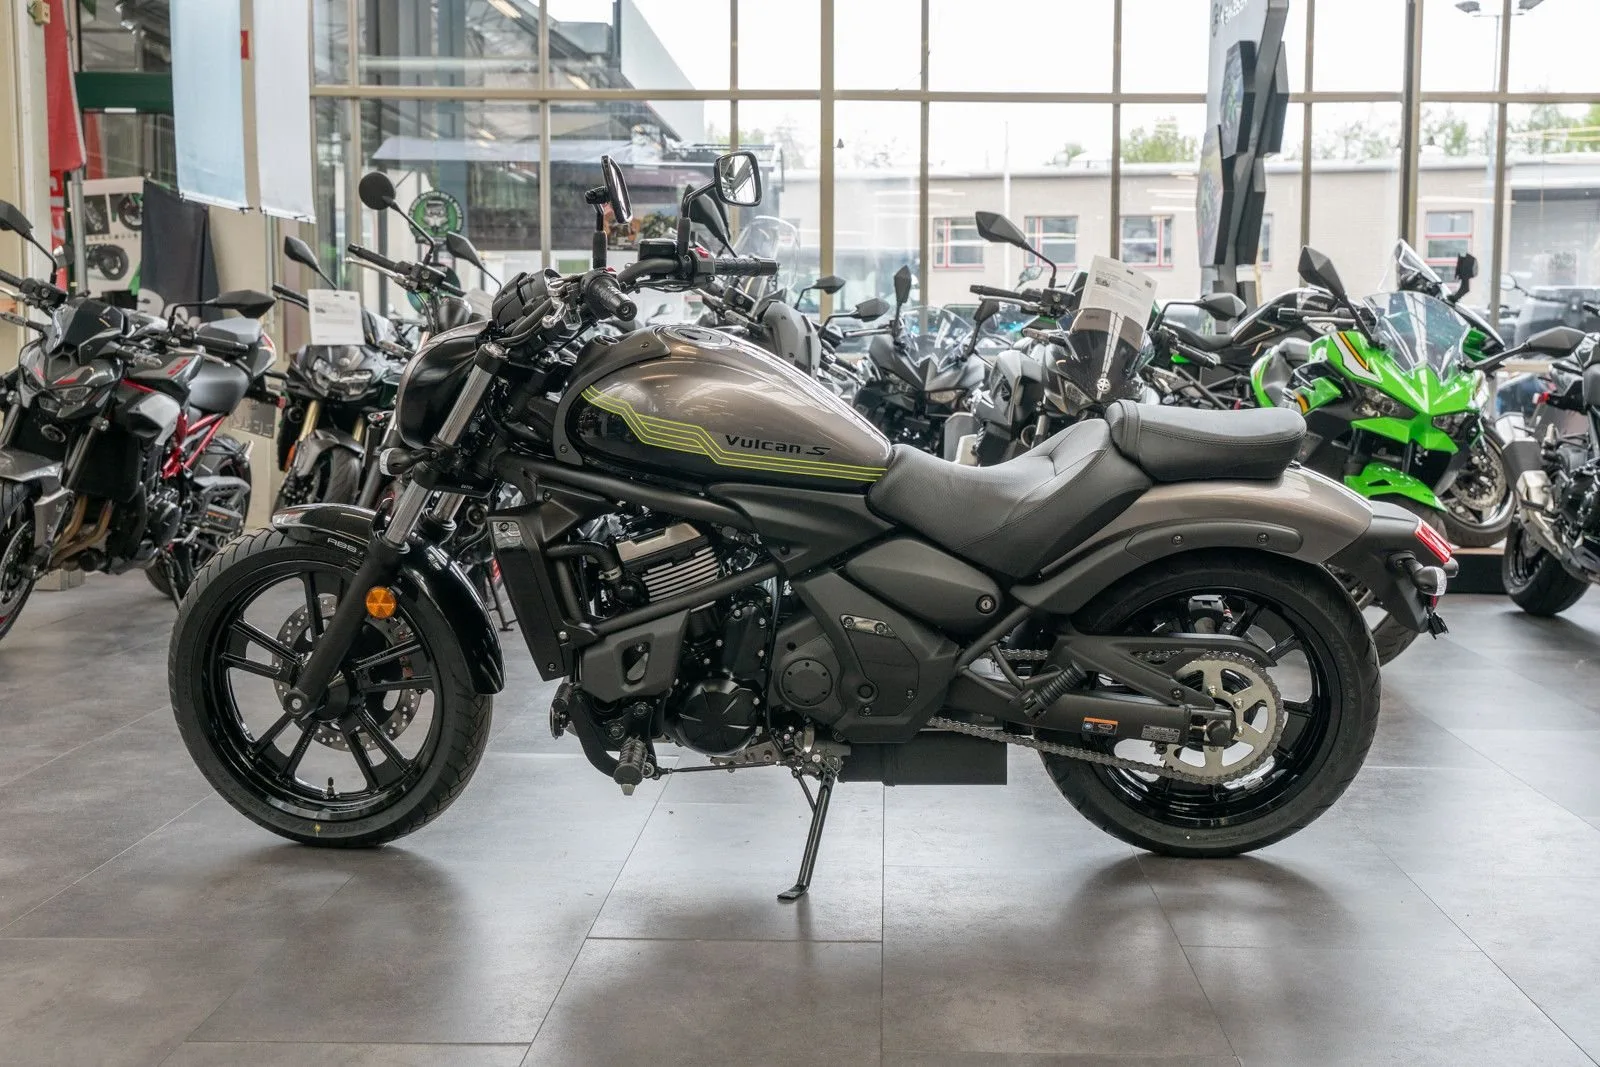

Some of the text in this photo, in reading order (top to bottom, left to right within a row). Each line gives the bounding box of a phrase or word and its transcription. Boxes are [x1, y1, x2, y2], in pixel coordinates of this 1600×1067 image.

[725, 434, 831, 456] Vulcan S
[327, 537, 357, 553] ABS
